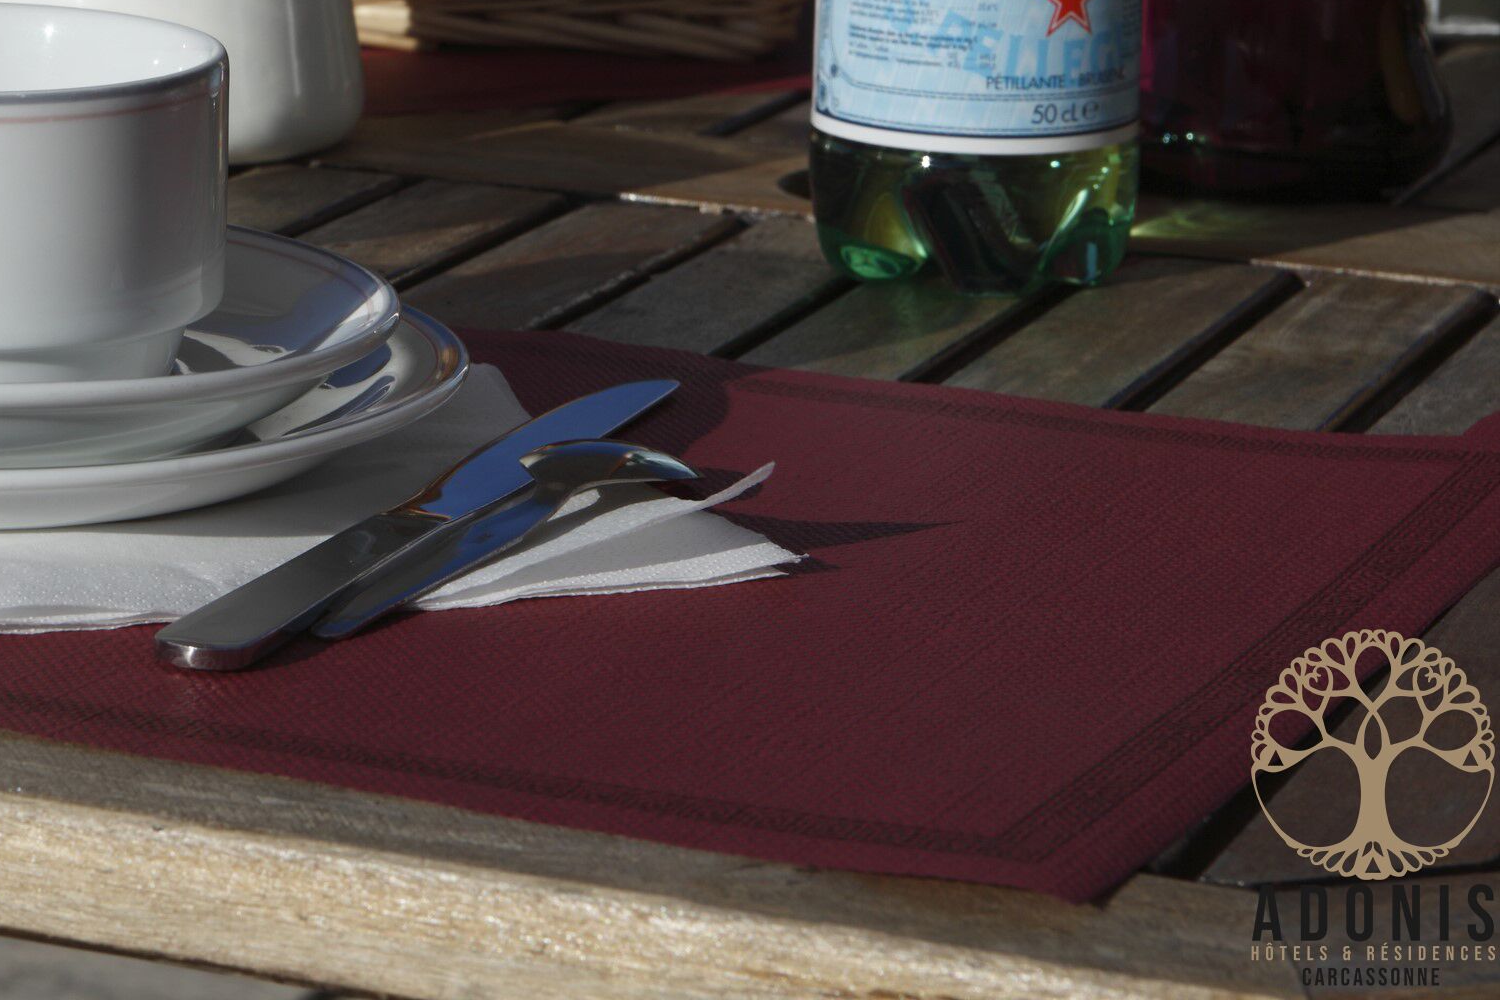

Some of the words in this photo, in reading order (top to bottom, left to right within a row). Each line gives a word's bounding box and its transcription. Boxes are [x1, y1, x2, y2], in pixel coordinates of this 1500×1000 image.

[986, 74, 1066, 91] PÉTILLANTE
[1031, 104, 1057, 124] 50
[1060, 103, 1078, 122] cl
